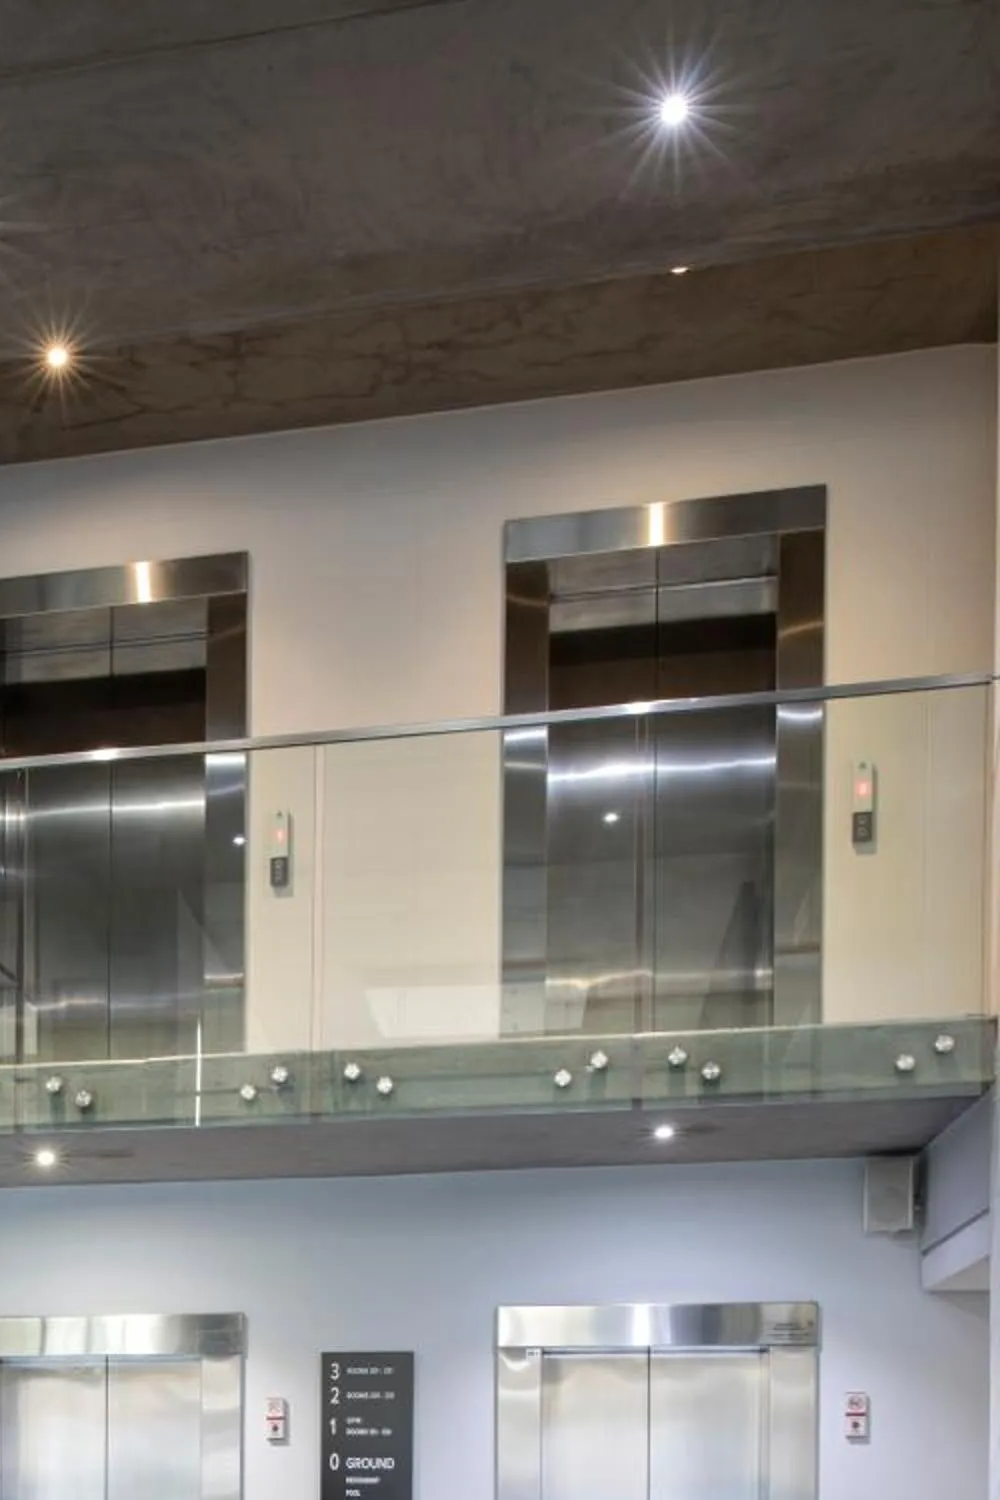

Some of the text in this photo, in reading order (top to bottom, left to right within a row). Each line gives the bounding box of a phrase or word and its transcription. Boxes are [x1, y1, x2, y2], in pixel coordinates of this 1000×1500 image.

[330, 1362, 340, 1380] 3
[330, 1387, 340, 1404] 2
[329, 1418, 336, 1435] 1
[329, 1453, 395, 1471] 0 GROUND
